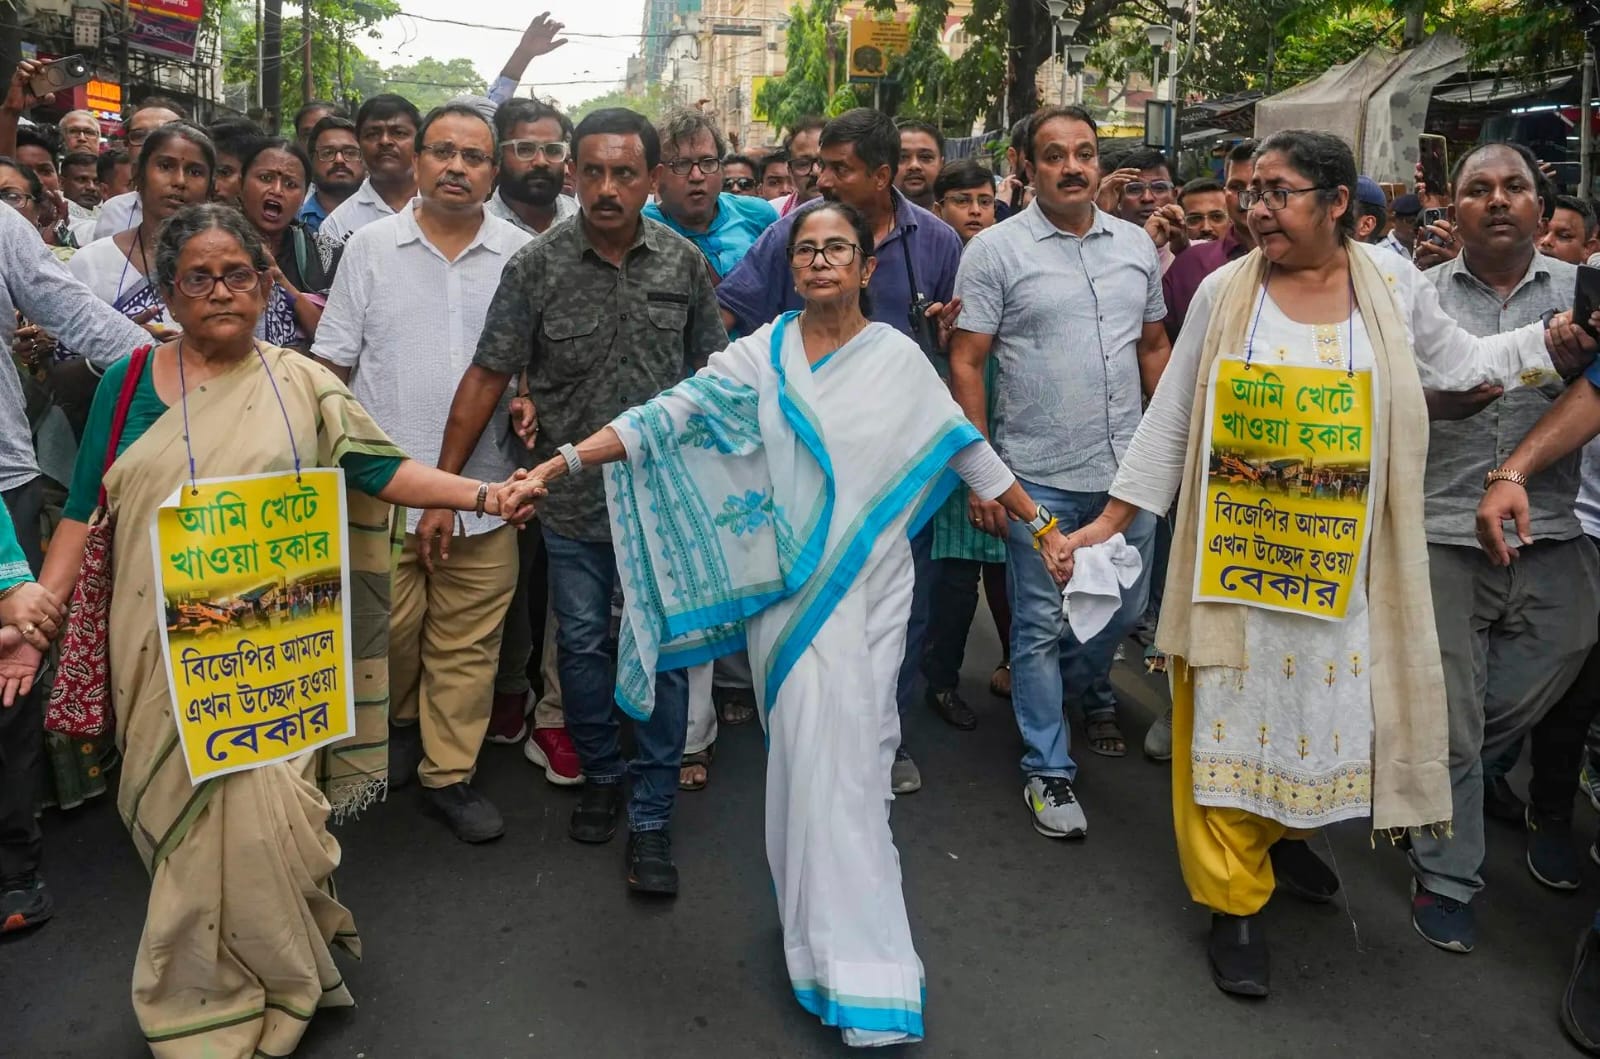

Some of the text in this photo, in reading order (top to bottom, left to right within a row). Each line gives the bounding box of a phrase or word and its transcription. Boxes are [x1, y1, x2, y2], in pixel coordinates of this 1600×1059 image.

[1231, 373, 1354, 414] আমি খেটে
[1222, 412, 1362, 453] খাওয়া হকার
[176, 486, 319, 536] আমি খেটে
[1214, 492, 1358, 541] বিজেপির আমলে
[170, 531, 330, 580] খাওয়া হকার
[1209, 534, 1354, 576] এখন উচ্ছেদ হওয়া
[1220, 565, 1340, 609] বেকার
[181, 629, 334, 686] বিজেপির আমলে
[186, 665, 337, 725] এখন উচ্ছেদ হওয়া
[206, 701, 330, 761] বেকার
